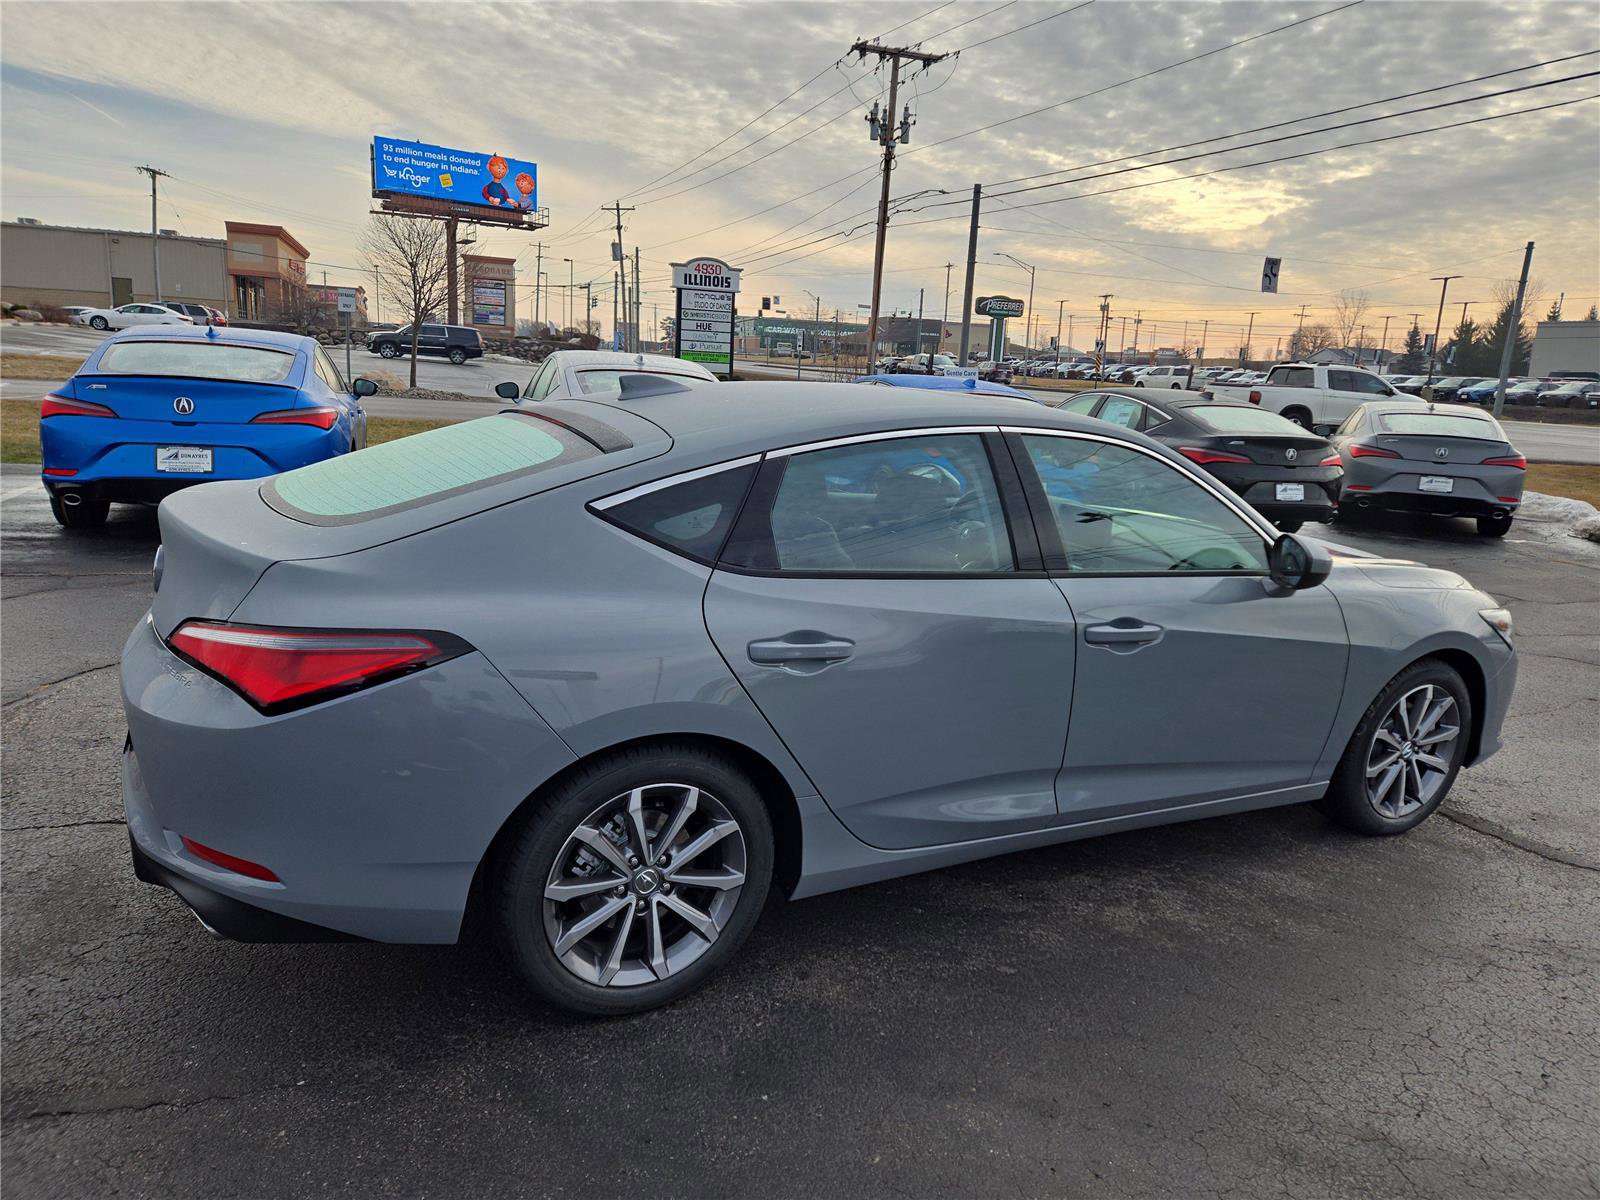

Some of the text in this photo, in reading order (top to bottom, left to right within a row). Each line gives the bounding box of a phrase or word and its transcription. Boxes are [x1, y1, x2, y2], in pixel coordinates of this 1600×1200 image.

[383, 144, 480, 167] 93 million meals donated
[394, 156, 410, 164] end
[411, 158, 439, 169] hunger
[399, 167, 430, 187] Kroger
[694, 263, 722, 276] 4930
[684, 273, 732, 288] ILLINOIS
[694, 301, 709, 309] STUDIO
[716, 303, 731, 311] DANCE
[985, 299, 1024, 311] PREFERRED
[695, 322, 713, 331] HUE
